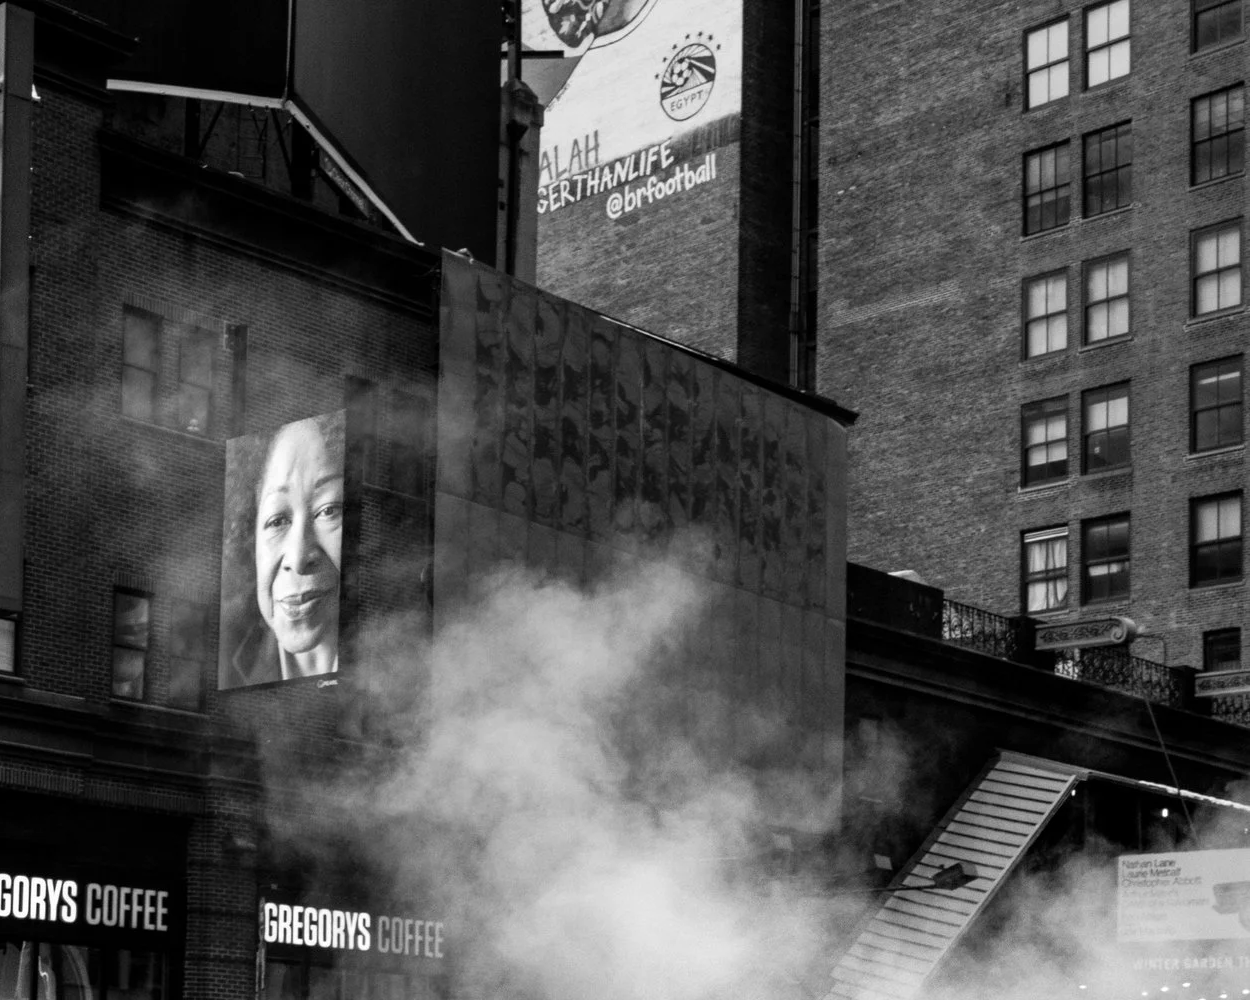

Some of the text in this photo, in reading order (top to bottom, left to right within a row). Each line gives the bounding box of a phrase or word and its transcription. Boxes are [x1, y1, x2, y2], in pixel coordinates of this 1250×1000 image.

[670, 91, 703, 112] EGYPT
[606, 153, 716, 219] @brfootball
[86, 883, 168, 931] COFFEE
[264, 901, 444, 958] GREGORYS COFFEE
